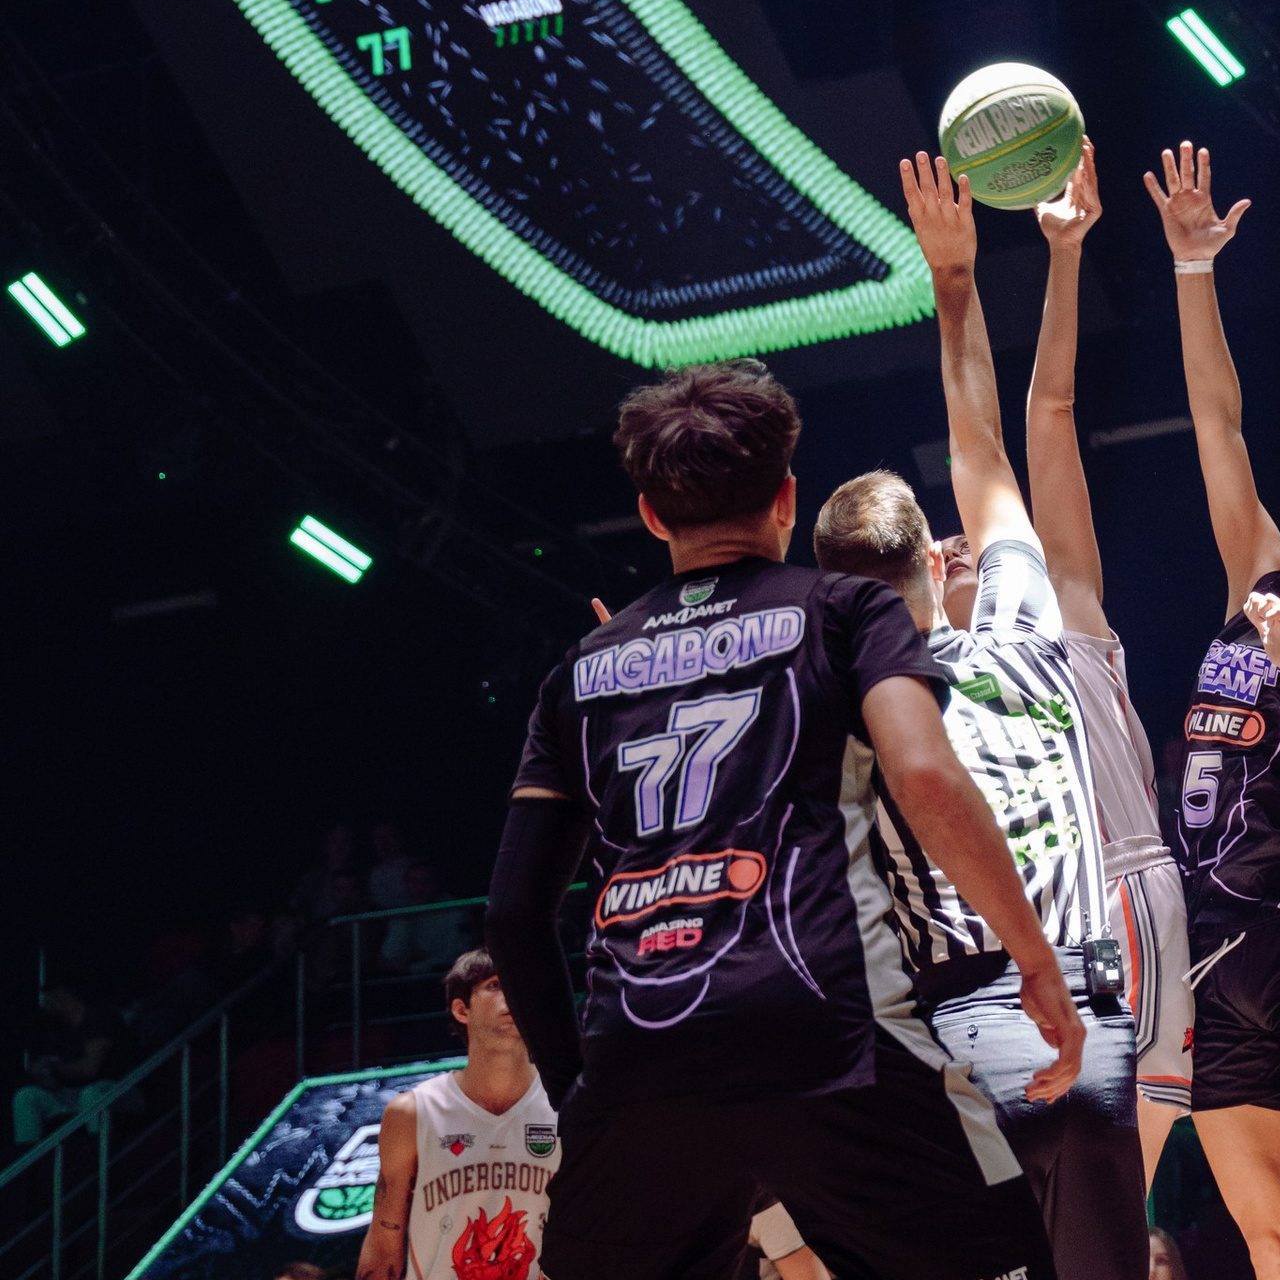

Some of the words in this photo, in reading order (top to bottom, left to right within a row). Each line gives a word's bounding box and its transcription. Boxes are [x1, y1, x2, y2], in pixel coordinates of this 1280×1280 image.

[356, 26, 412, 75] 77
[955, 110, 1003, 159] MEDIA
[988, 94, 1053, 141] BASKET
[575, 607, 805, 701] VAGABOND
[618, 686, 763, 837] 77
[1182, 751, 1222, 828] 5
[604, 861, 724, 917] WINLINE
[636, 928, 703, 957] RED
[640, 917, 703, 940] AMAZING
[423, 1161, 557, 1213] UNDERGROU
